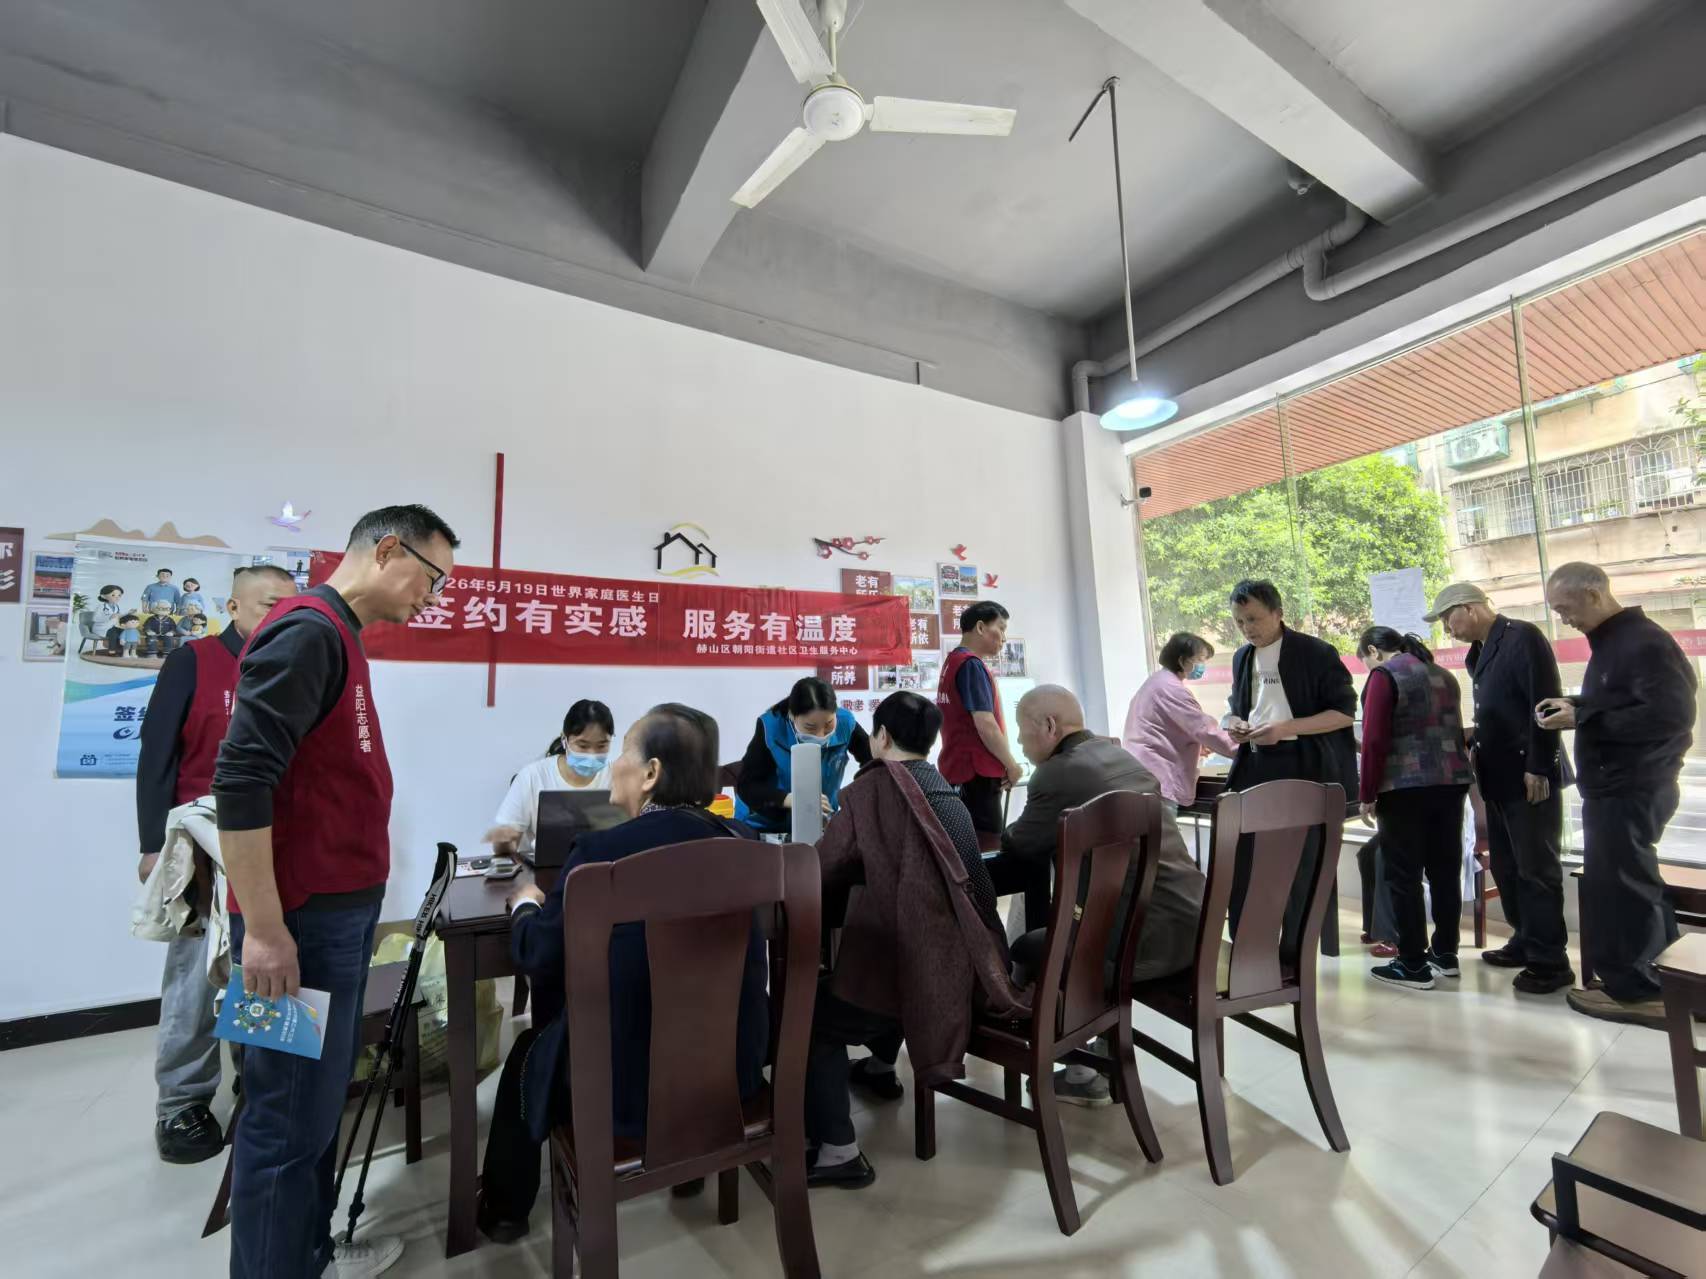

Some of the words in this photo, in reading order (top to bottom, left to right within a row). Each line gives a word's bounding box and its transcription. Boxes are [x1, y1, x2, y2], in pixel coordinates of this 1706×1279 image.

[855, 574, 879, 588] 老有
[408, 596, 648, 637] 签约有实感
[682, 609, 857, 643] 服务有温度
[696, 642, 858, 655] 赫山区朝阳街道社区卫生服务中心
[355, 684, 371, 753] 益阳志愿者
